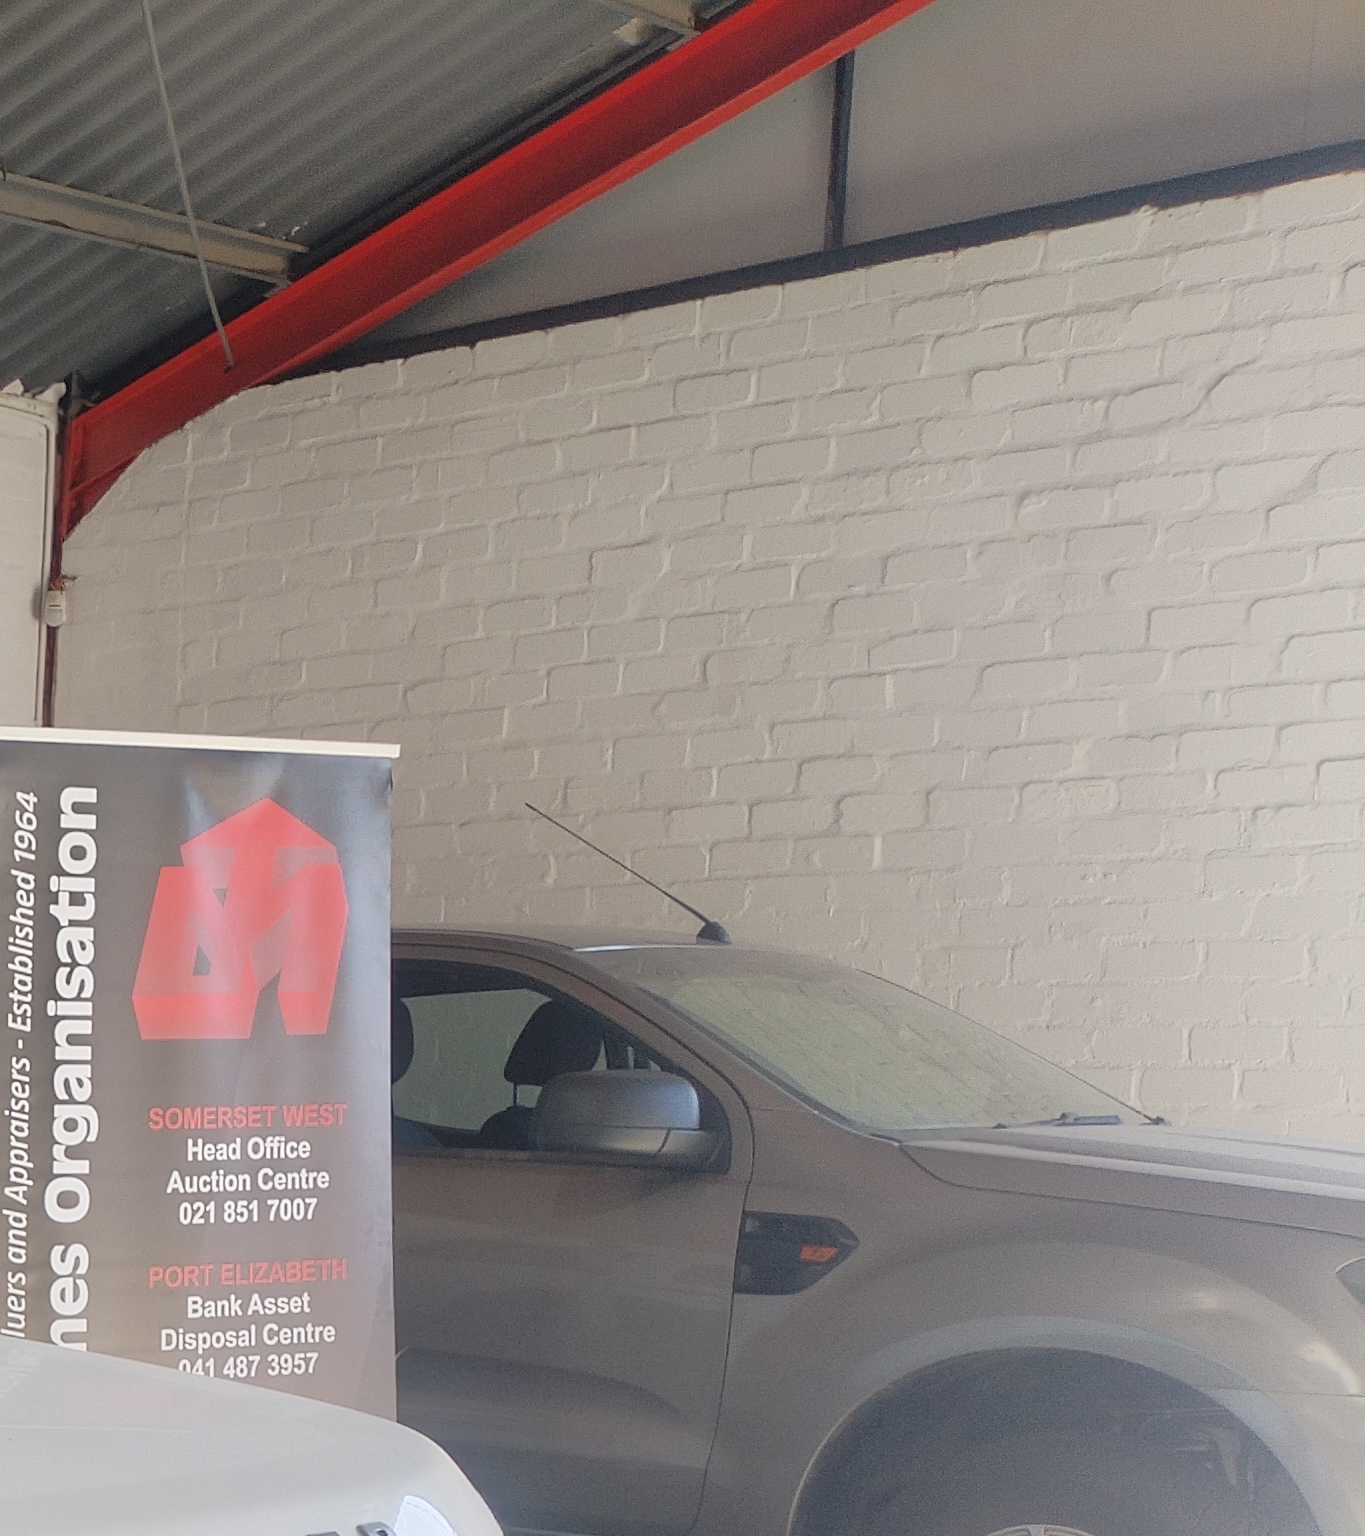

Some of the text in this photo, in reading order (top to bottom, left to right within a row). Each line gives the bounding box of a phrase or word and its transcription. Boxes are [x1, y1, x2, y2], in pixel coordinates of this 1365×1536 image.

[13, 791, 38, 862] 1964
[8, 869, 36, 1032] Established
[43, 786, 100, 1223] Organisation
[3, 1056, 34, 1206] Appraisers
[148, 1103, 348, 1130] SOMERSET WEST
[187, 1136, 311, 1161] Head Office
[166, 1167, 330, 1194] Auction Centre
[179, 1197, 318, 1225] 021 851 7007
[2, 1209, 28, 1264] and
[148, 1258, 348, 1289] PORT ELIZABETH
[0, 1271, 27, 1338] luers
[187, 1292, 311, 1319] Bank Asset
[161, 1322, 336, 1354] Disposal Centre
[223, 1355, 261, 1379] 487
[267, 1352, 319, 1376] 3957
